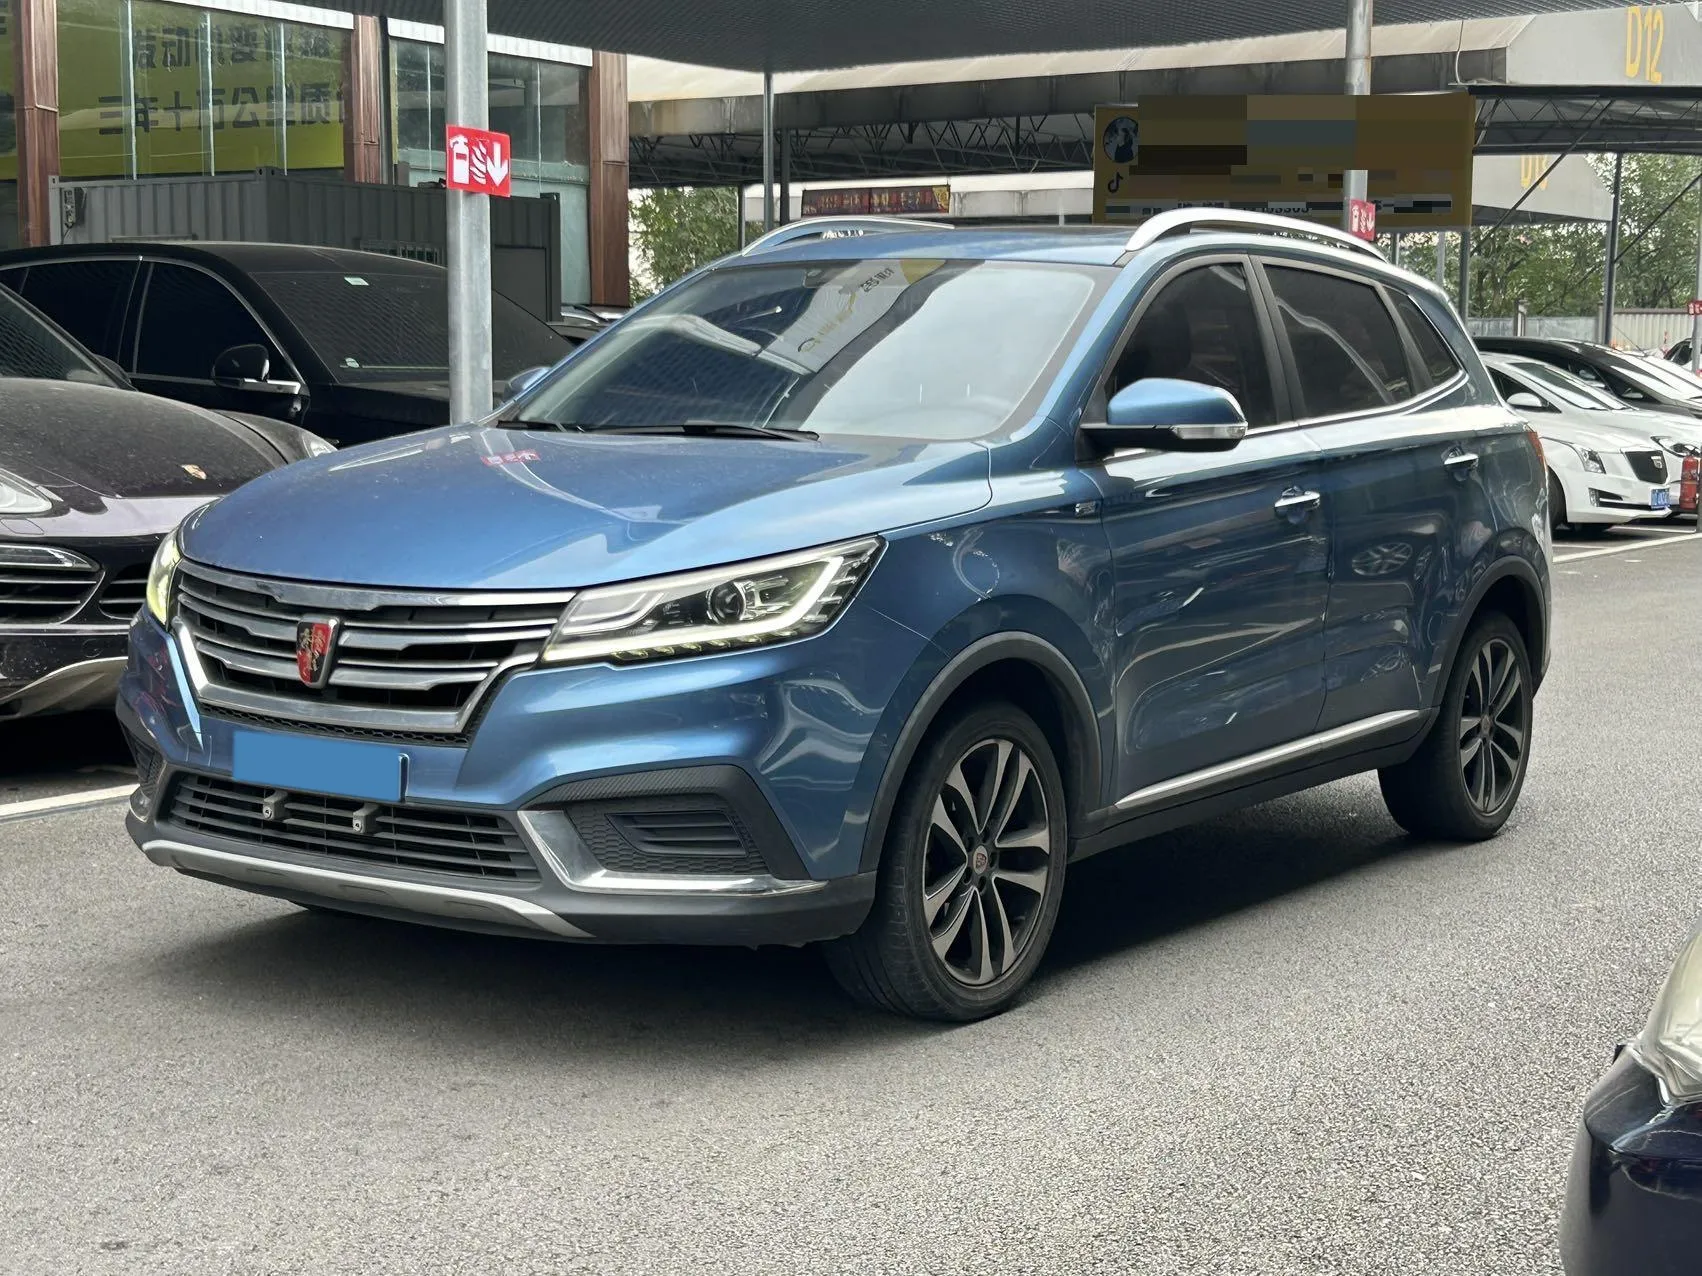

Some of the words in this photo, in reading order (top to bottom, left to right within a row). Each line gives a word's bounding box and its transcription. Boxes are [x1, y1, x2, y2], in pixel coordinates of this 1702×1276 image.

[1625, 6, 1664, 84] D12
[98, 83, 344, 135] 三年十万公里质
